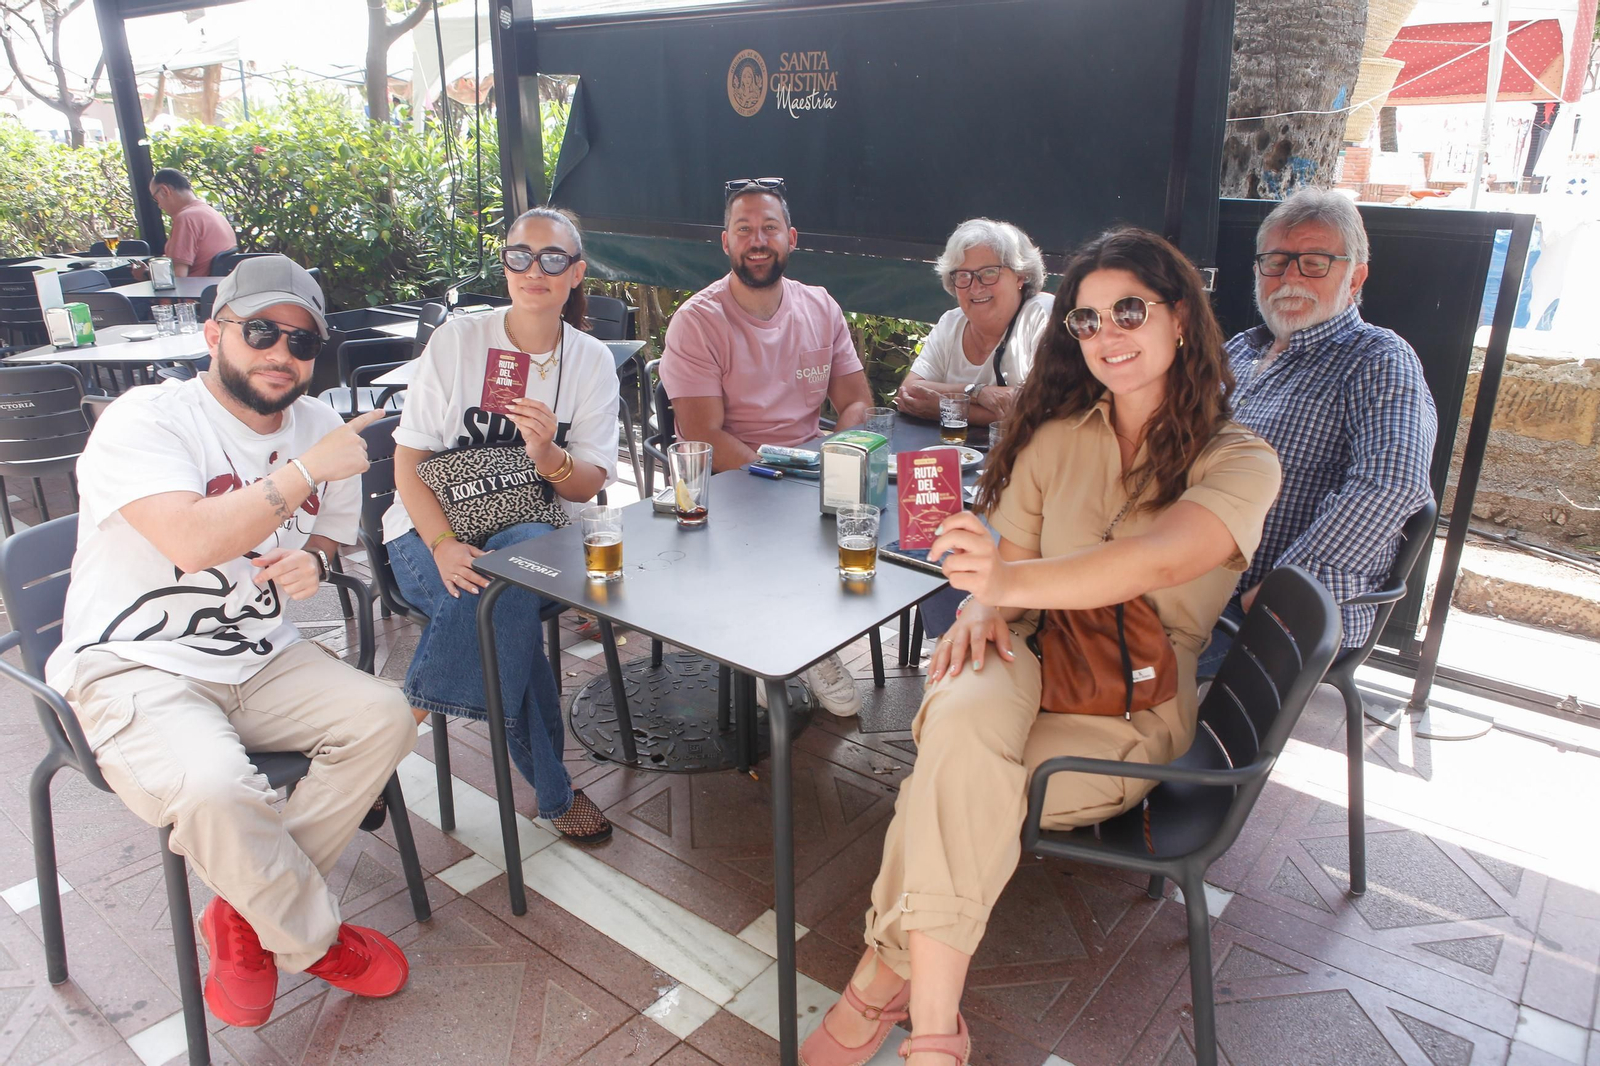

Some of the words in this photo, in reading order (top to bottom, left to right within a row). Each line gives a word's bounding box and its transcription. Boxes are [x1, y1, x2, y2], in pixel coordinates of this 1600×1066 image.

[780, 51, 829, 71] SANTA
[770, 72, 837, 92] CRISTINA
[776, 83, 837, 119] Maestría
[499, 360, 515, 370] RUTA
[796, 363, 831, 379] SCALP
[499, 369, 511, 378] DEL
[496, 377, 513, 387] ATÚN
[0, 402, 35, 410] CTORIA
[914, 466, 938, 479] RUTA
[450, 479, 487, 502] KOKI
[486, 476, 497, 491] Y
[918, 479, 936, 491] DEL
[915, 490, 940, 505] ATÚN
[508, 556, 559, 578] VICTORIA
